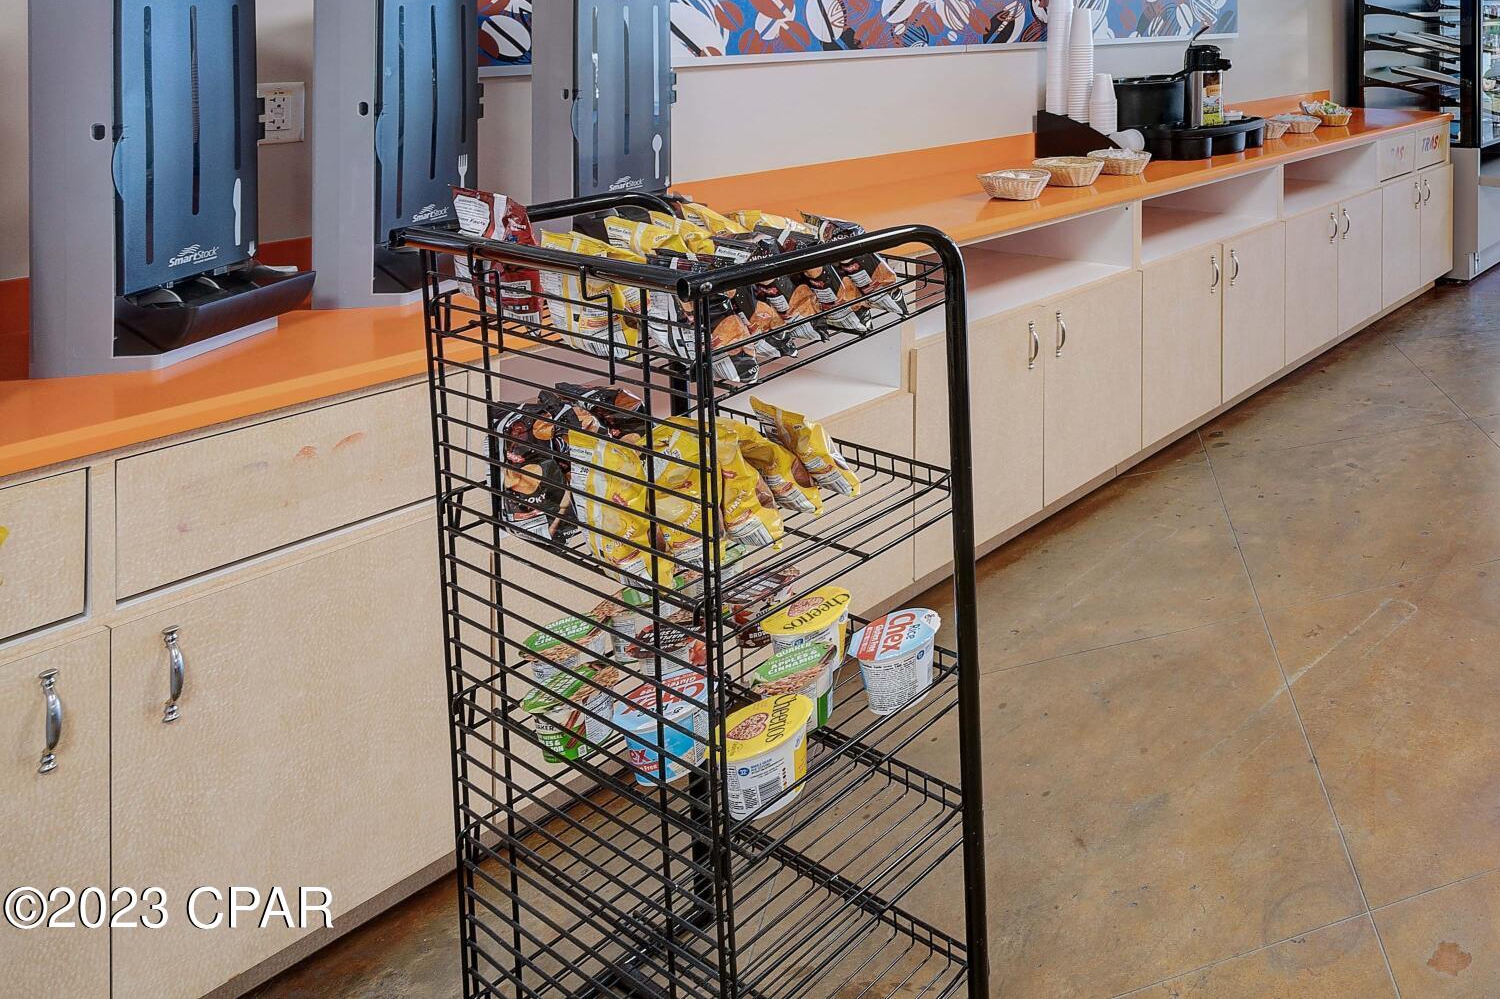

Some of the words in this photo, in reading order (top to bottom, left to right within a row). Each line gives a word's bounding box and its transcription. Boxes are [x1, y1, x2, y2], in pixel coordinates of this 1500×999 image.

[609, 179, 643, 191] SmartStock
[412, 206, 448, 223] SmartStock
[168, 247, 219, 268] SmartStock
[783, 593, 850, 631] Cheerios
[880, 613, 916, 654] Chex
[776, 642, 811, 658] QUAKER
[768, 653, 821, 674] CINNAMON
[771, 653, 809, 670] APPLES
